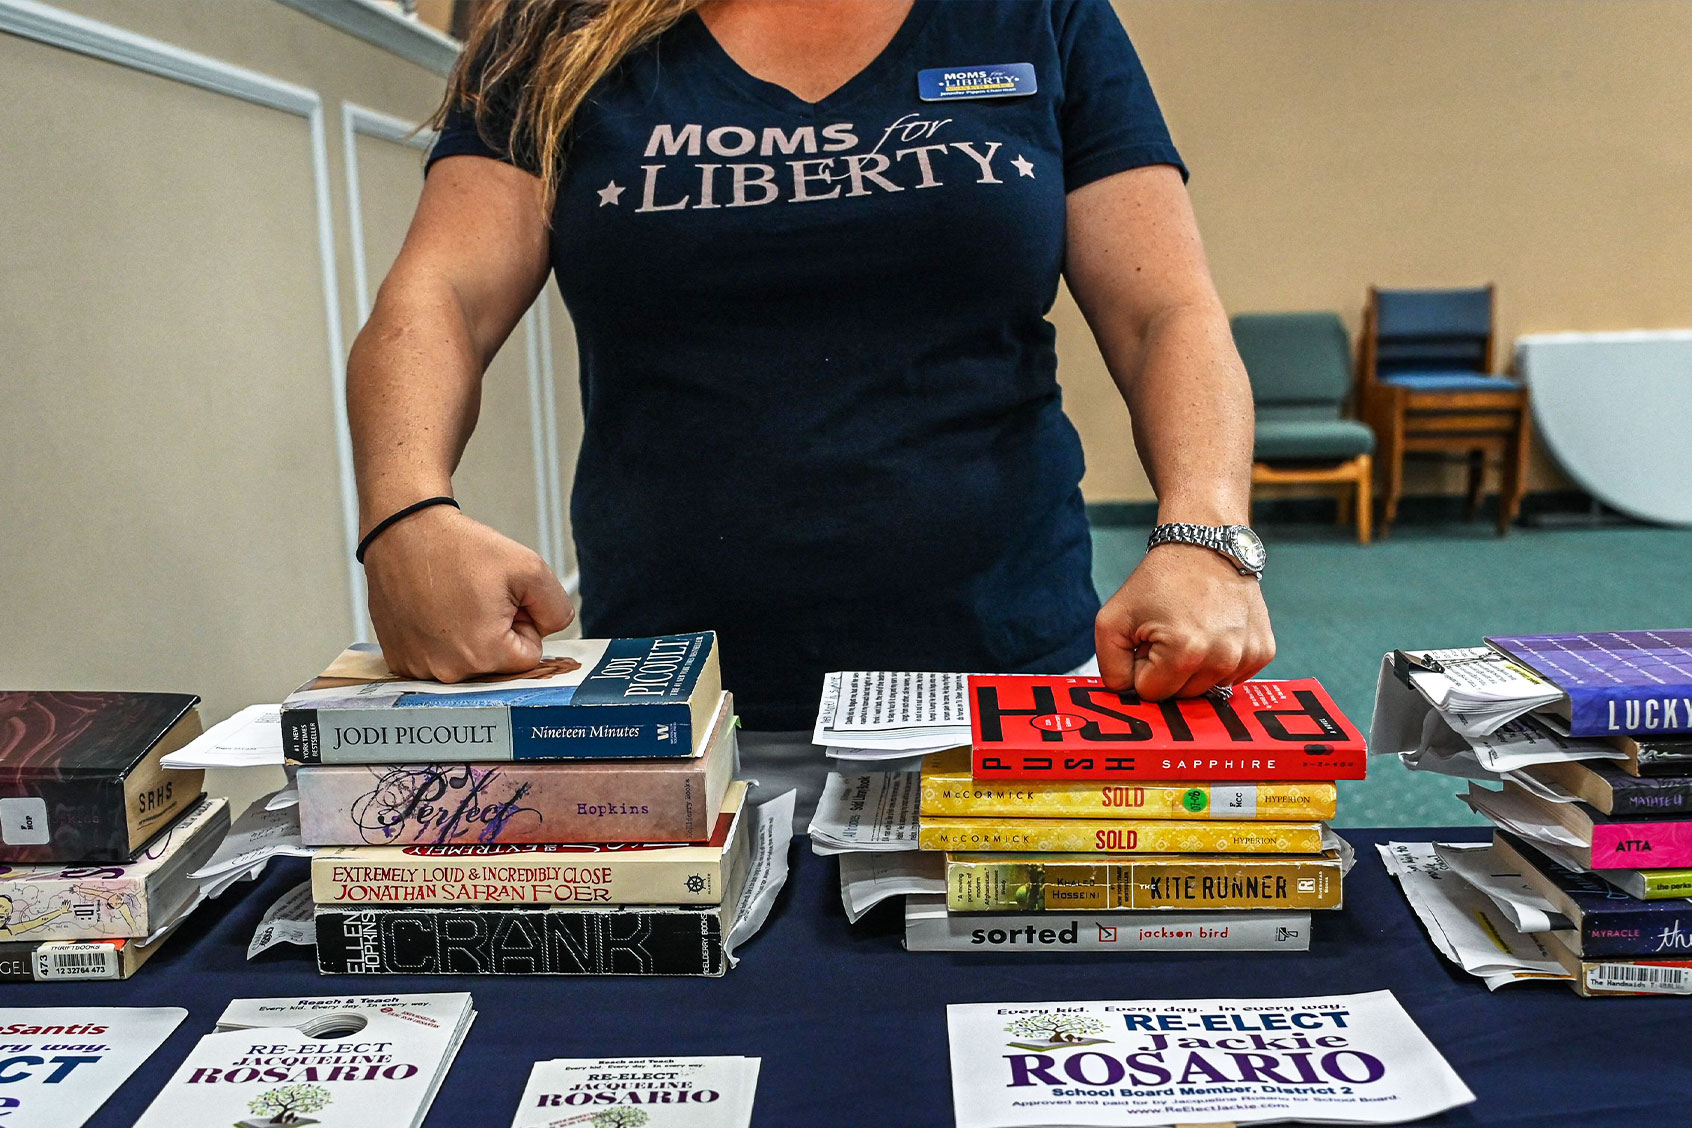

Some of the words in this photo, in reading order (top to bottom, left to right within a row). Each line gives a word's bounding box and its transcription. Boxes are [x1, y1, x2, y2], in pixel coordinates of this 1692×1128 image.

[944, 71, 986, 80] MOMS
[945, 76, 1015, 87] LIBERTY
[643, 123, 859, 157] MOMS
[635, 142, 1004, 213] LIBERTY
[590, 656, 642, 680] JODI
[623, 639, 690, 697] PICOULT
[1608, 698, 1692, 731] LUCKY
[333, 725, 387, 750] JODI
[394, 724, 497, 746] PICOULT
[531, 725, 586, 739] Nineteen
[589, 724, 640, 739] Minutes
[982, 757, 1135, 771] PUSH
[1162, 759, 1276, 769] SAPPHIRE
[138, 781, 173, 814] SRHS
[943, 789, 1035, 800] McCORMICK
[1102, 786, 1145, 808] SOLD
[1264, 794, 1311, 804] HYPERION
[350, 764, 544, 846] Perfect
[576, 801, 650, 816] Hopkins
[26, 815, 34, 831] HOP
[940, 834, 1030, 843] McCORMICK
[1095, 829, 1138, 850] SOLD
[1233, 835, 1277, 845] HYPERION
[1615, 840, 1652, 852] ATTA
[332, 866, 418, 884] EXTREMELY
[421, 867, 464, 883] LOUD
[469, 867, 480, 881] &
[482, 865, 562, 884] INCREDIBLY
[563, 866, 612, 885] CLOSE
[333, 884, 437, 902] JONATHAN
[441, 884, 525, 902] SAFRAN
[532, 883, 612, 903] FOER
[1151, 876, 1197, 900] KITE
[1201, 875, 1288, 899] RUNNER
[1656, 883, 1670, 891] the
[1670, 883, 1692, 891] perks
[1051, 890, 1101, 901] HOSSEINI
[700, 913, 708, 935] BOOKS
[970, 920, 1078, 945] sorted
[1139, 927, 1195, 941] jackson
[1200, 927, 1229, 939] bird
[1591, 929, 1640, 938] MYRACLE
[1655, 919, 1692, 952] th
[346, 912, 363, 975] ELLEN
[363, 913, 377, 974] HOPKINS
[381, 913, 654, 974] CRANK
[40, 954, 49, 976] 473
[67, 967, 90, 975] 32764
[1590, 978, 1604, 986] The
[996, 1008, 1050, 1016] Every
[0, 1023, 110, 1035] Santis
[1123, 1010, 1351, 1032] RE-ELECT
[40, 1044, 112, 1053] way.
[246, 1042, 393, 1055] RE-ELECT
[1138, 1032, 1350, 1052] Jackie
[232, 1054, 393, 1067] JACQUELINE
[1002, 1049, 1386, 1088] ROSARIO
[0, 1055, 103, 1084] CT
[184, 1063, 419, 1084] ROSARIO
[587, 1072, 679, 1081] RE-ELECT
[568, 1081, 694, 1091] JACQUELINE
[1052, 1087, 1115, 1097] School
[1119, 1087, 1175, 1097] Board
[1179, 1085, 1257, 1096] Member,
[1261, 1085, 1337, 1095] District
[1339, 1085, 1354, 1095] 2
[537, 1089, 720, 1108] ROSARIO
[1012, 1099, 1072, 1107] Approved
[1126, 1102, 1290, 1114] www.ReElectJackie.com
